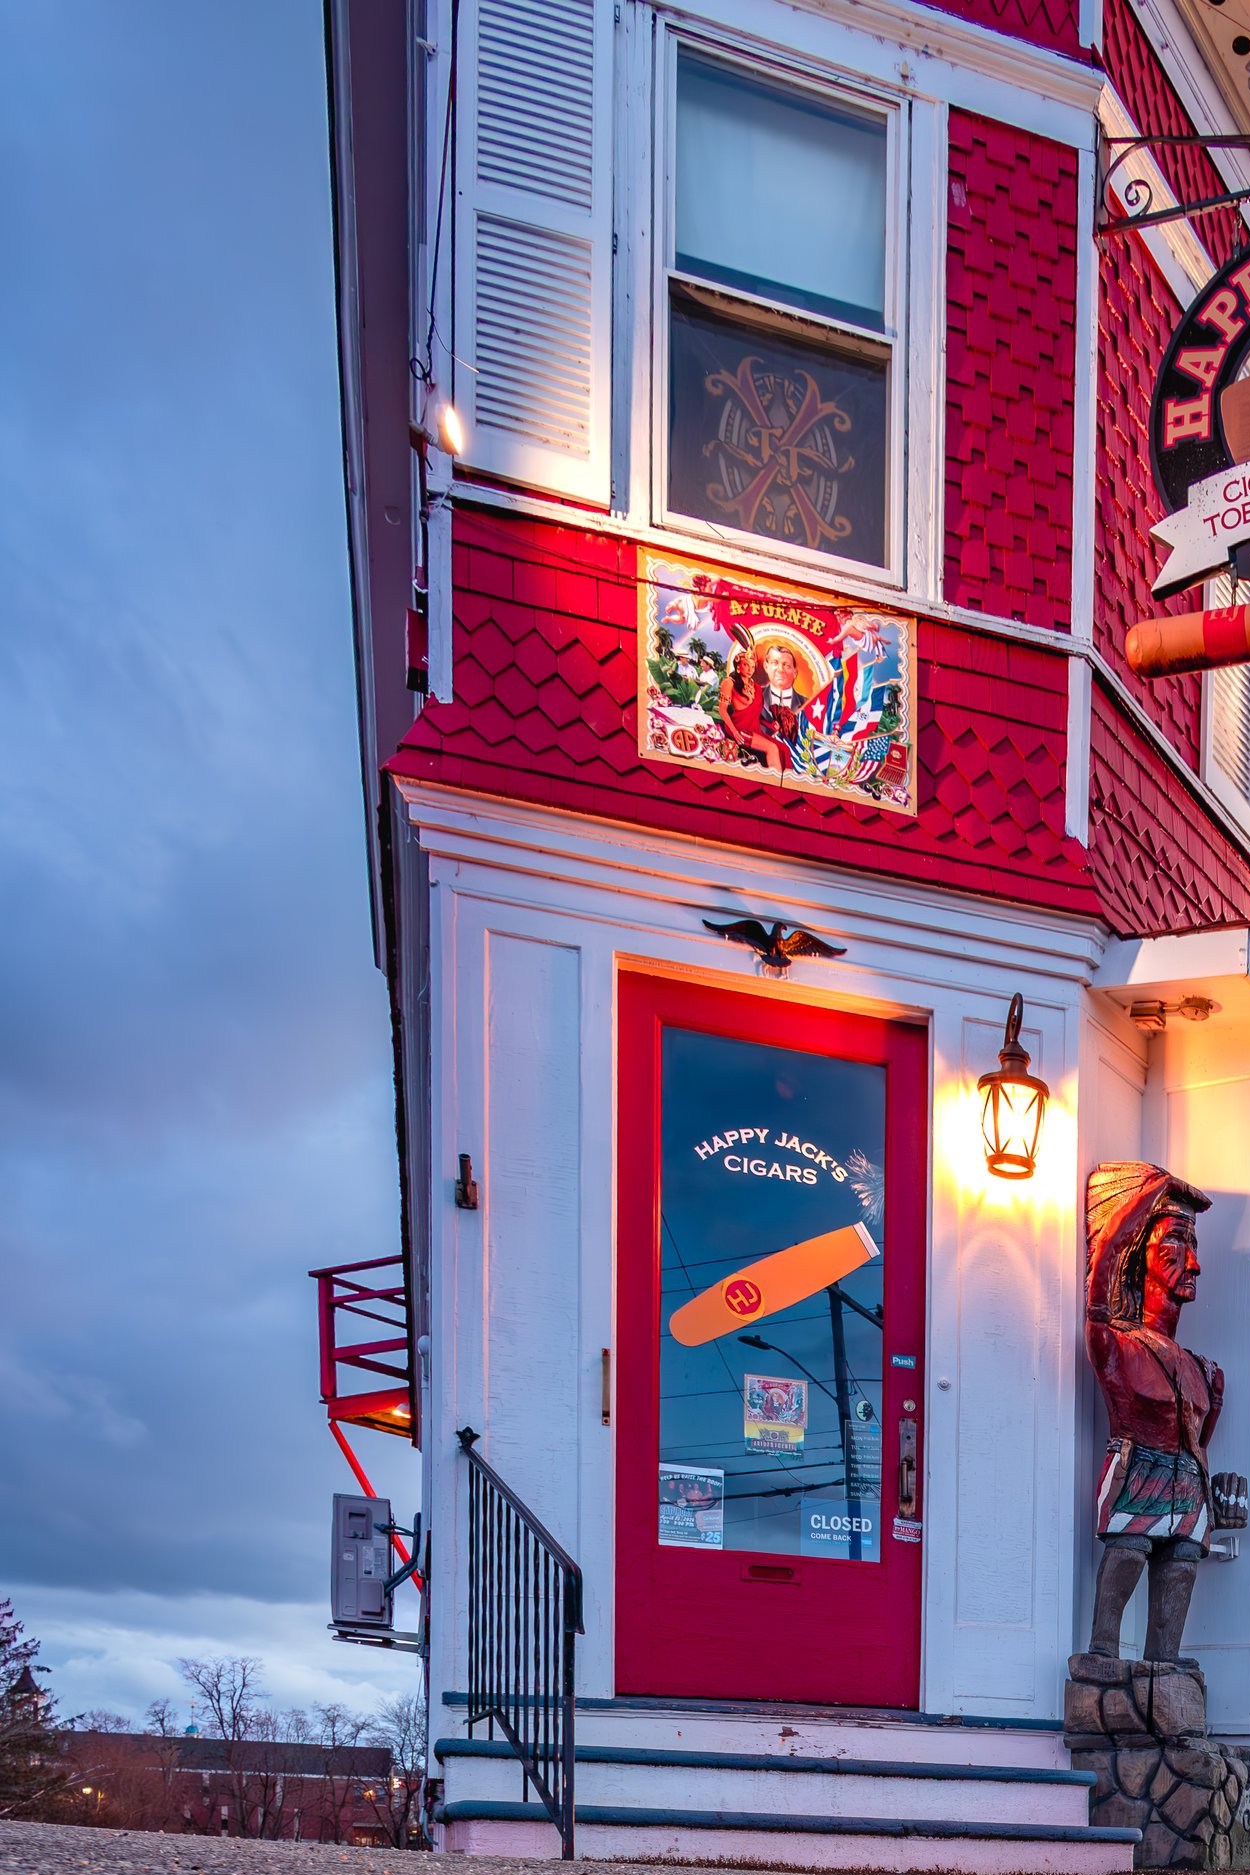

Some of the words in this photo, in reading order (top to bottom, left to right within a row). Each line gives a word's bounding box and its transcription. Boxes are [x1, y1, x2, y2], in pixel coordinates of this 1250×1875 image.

[694, 1127, 770, 1161] HAPPY
[774, 1131, 849, 1184] JACK'S
[723, 1155, 817, 1185] CIGARS
[727, 1282, 758, 1311] HJ
[892, 1357, 914, 1367] Push
[810, 1514, 872, 1533] CLOSED
[700, 1531, 721, 1543] $25
[810, 1532, 831, 1541] COME
[833, 1534, 852, 1542] BACK
